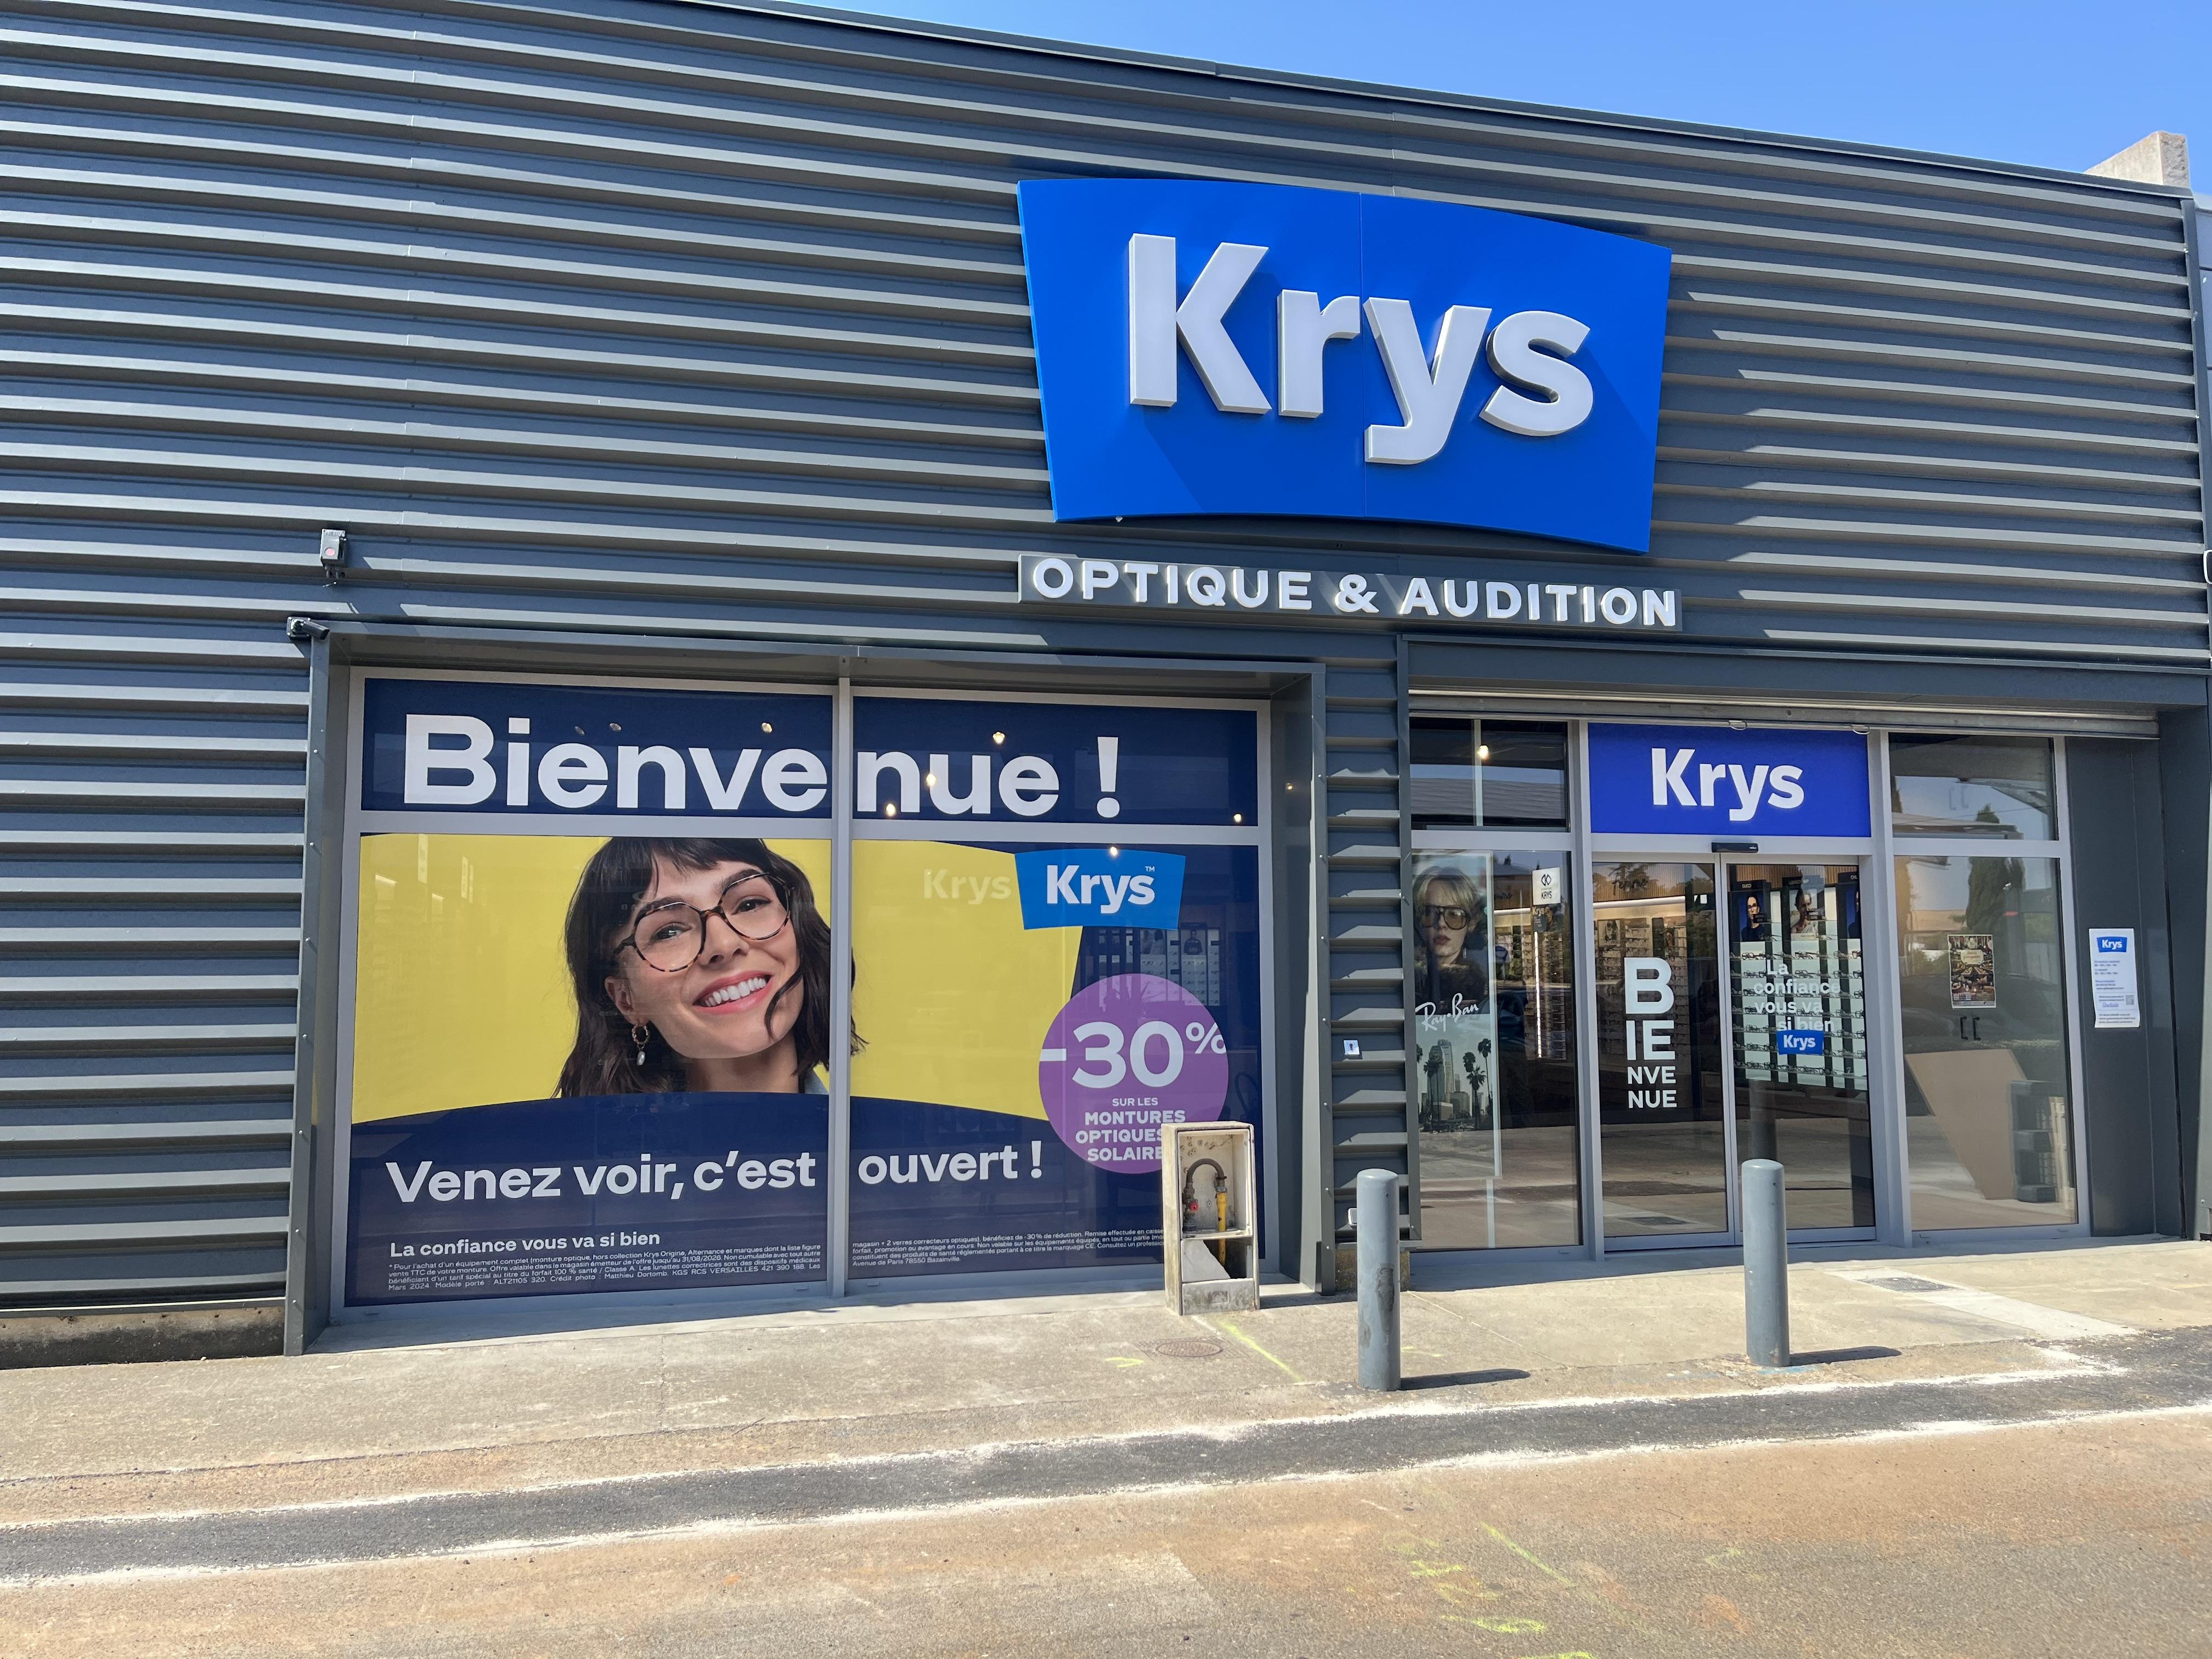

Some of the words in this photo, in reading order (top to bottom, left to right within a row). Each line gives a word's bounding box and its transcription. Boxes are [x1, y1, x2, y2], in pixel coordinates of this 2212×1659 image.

[1129, 233, 1594, 465] Krys
[1033, 557, 1313, 610] OPTIQUE
[1335, 573, 1379, 614] &
[1399, 577, 1677, 628] AUDITION
[1651, 748, 1805, 821] Krys
[1047, 865, 1155, 914] Krys
[2102, 939, 2123, 950] Krys
[1766, 959, 1789, 975] La
[1753, 978, 1841, 994] confiance
[1754, 1001, 1797, 1014] vous
[1802, 1002, 1824, 1013] va
[1778, 1017, 1792, 1031] si
[1796, 1018, 1835, 1032] bien
[1783, 1034, 1816, 1051] Krys
[1627, 1066, 1676, 1085] NVE
[1112, 1098, 1135, 1107] SUR
[1137, 1097, 1159, 1105] LES
[1628, 1090, 1677, 1108] NUE
[1085, 1109, 1186, 1126] MONTURES
[385, 1161, 561, 1203] Venez
[573, 1153, 685, 1200] voir,
[857, 1144, 1018, 1185] ouvert
[391, 1243, 415, 1257] La
[420, 1239, 517, 1256] confiance
[522, 1238, 567, 1251] vous
[572, 1237, 595, 1248] va
[600, 1232, 614, 1247] si
[620, 1231, 660, 1246] bien
